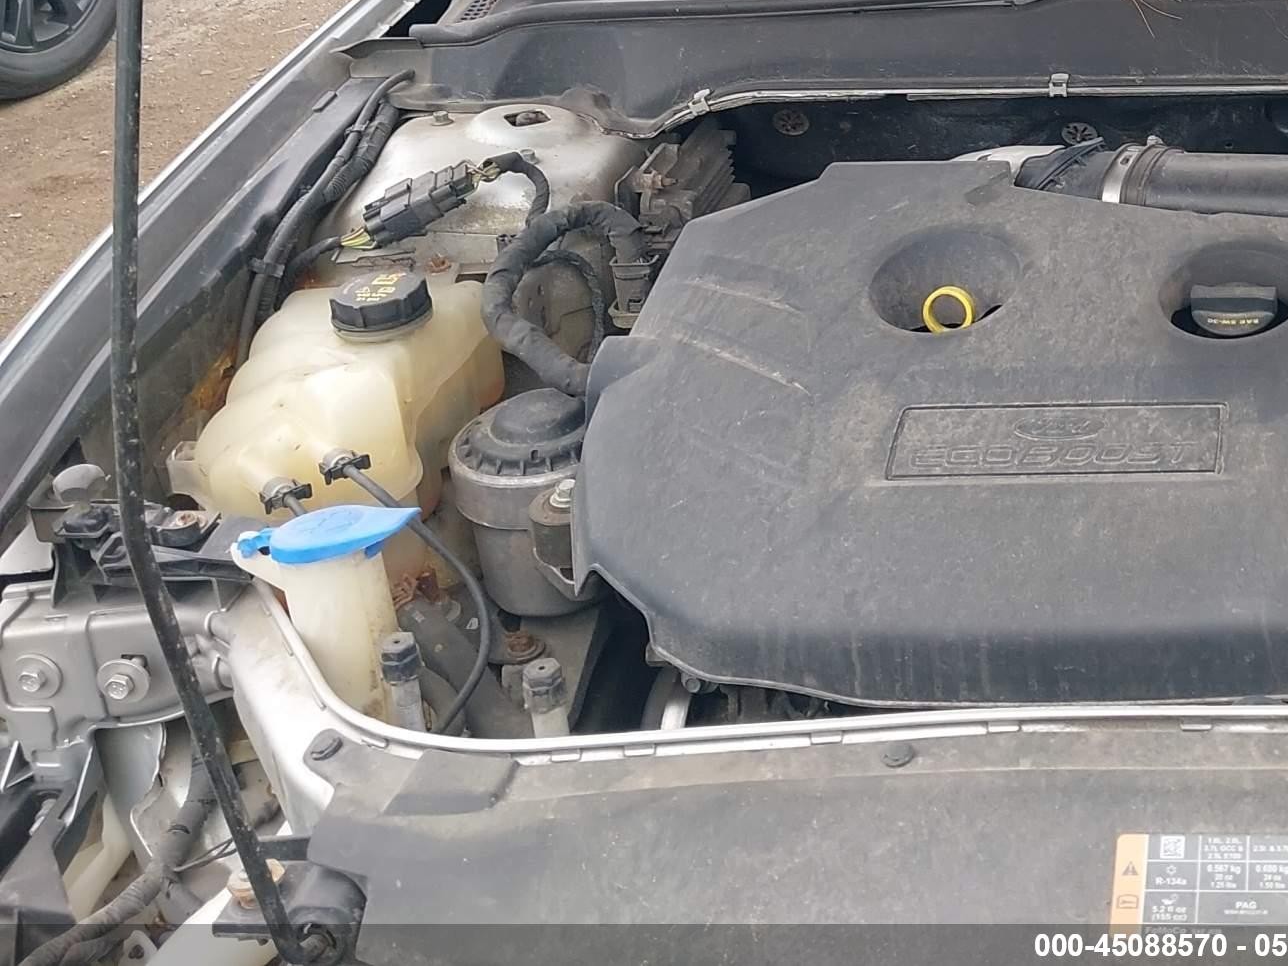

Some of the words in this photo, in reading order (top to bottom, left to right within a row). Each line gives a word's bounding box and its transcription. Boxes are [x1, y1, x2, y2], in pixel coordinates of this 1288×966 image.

[911, 442, 1199, 467] ECOBOOST
[1155, 877, 1187, 885] R-134a
[1235, 901, 1257, 909] PAG
